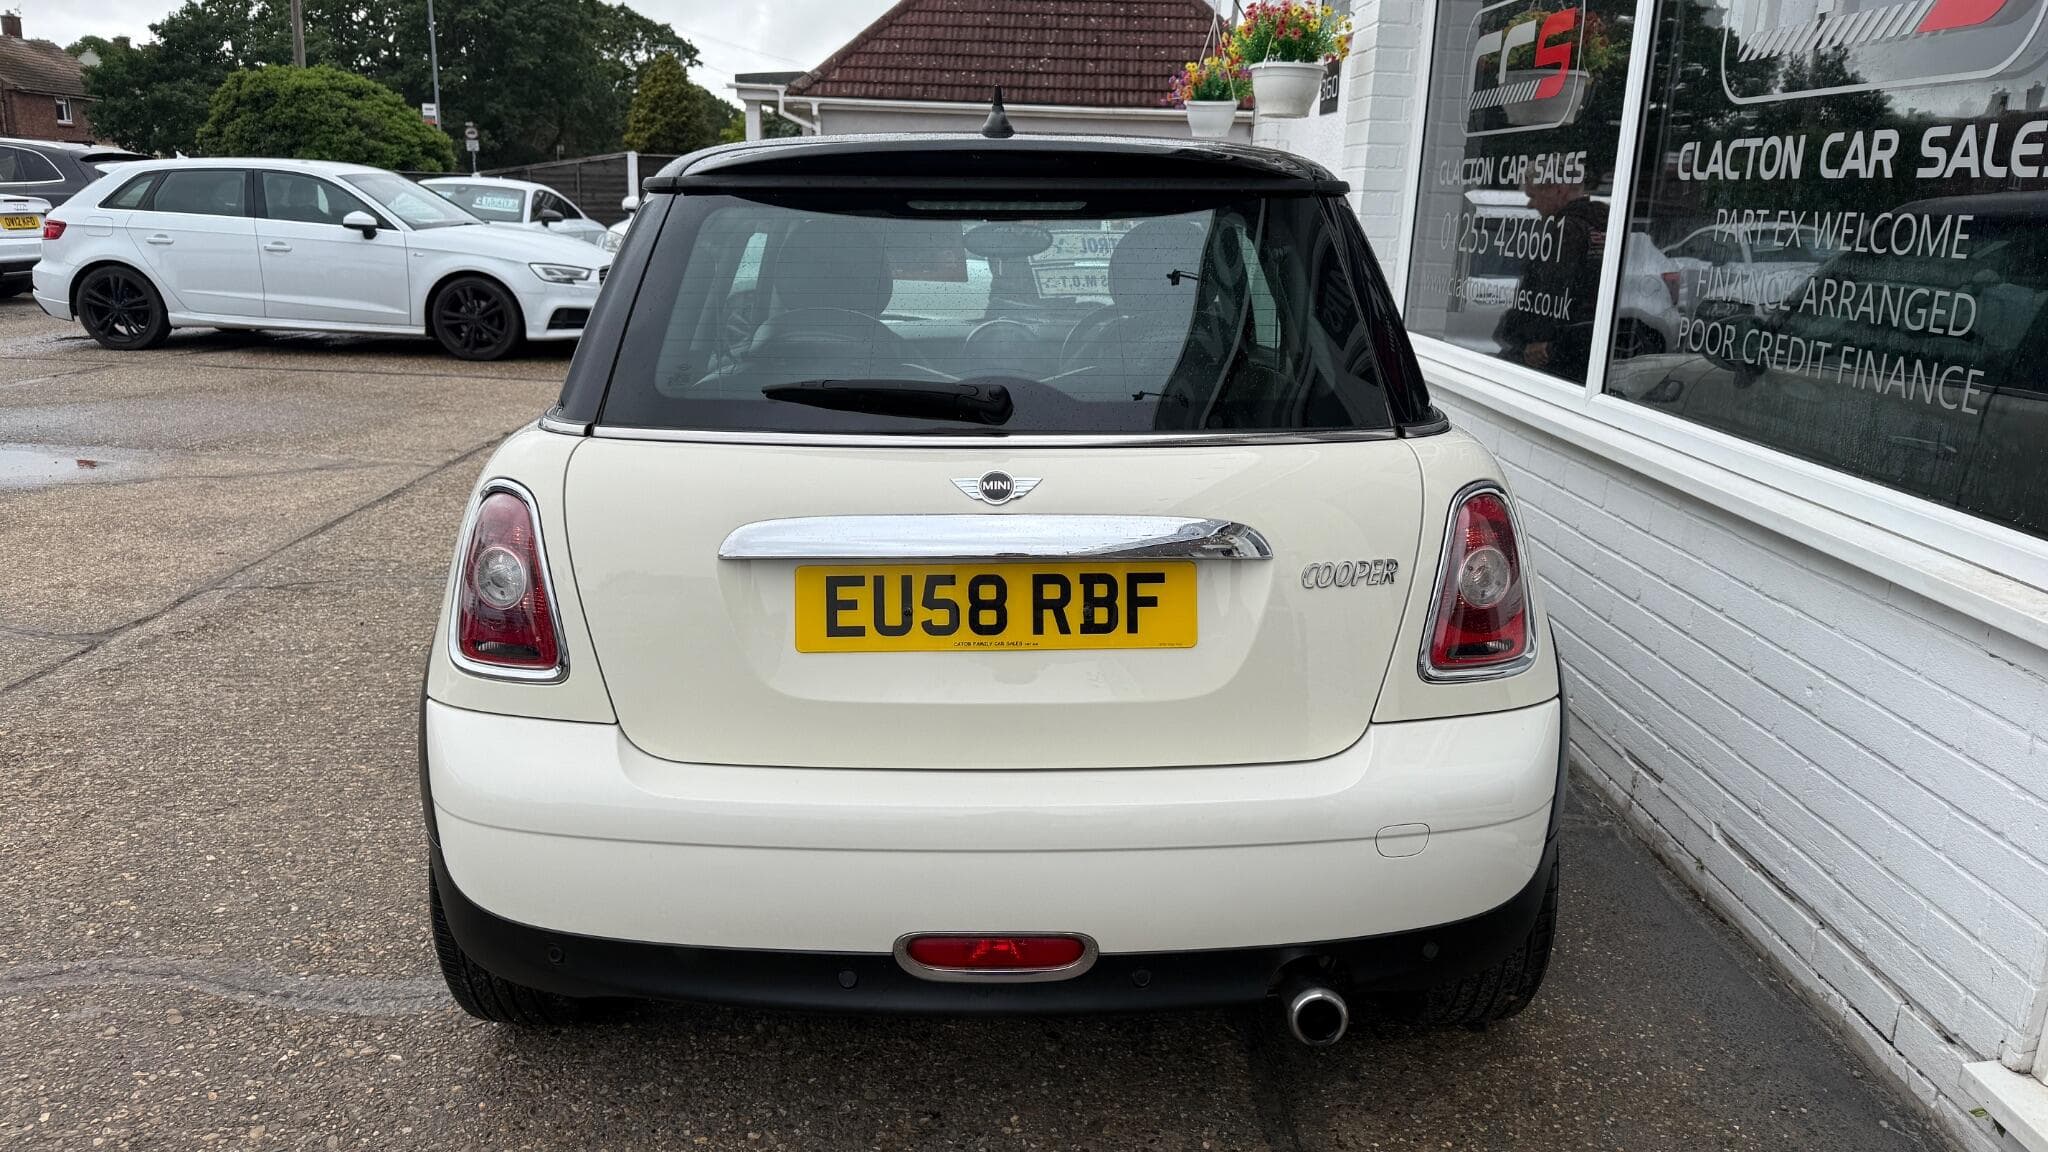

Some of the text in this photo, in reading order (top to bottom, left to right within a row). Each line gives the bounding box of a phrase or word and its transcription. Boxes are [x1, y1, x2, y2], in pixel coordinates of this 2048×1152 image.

[1439, 150, 1588, 186] CLACTON CAR SALES
[1677, 120, 2048, 181] CLACTON CAR SALE
[1440, 211, 1489, 255] 01255
[1494, 213, 1567, 264] 426661
[1713, 208, 1975, 260] PART EX WELCOME
[1696, 266, 1977, 338] FINANCE ARRANGED
[1676, 316, 1985, 416] POOR CREDIT FINANCE
[982, 480, 1011, 491] MINI
[1300, 558, 1399, 589] COOPER
[825, 572, 1166, 638] EU58 RBF
